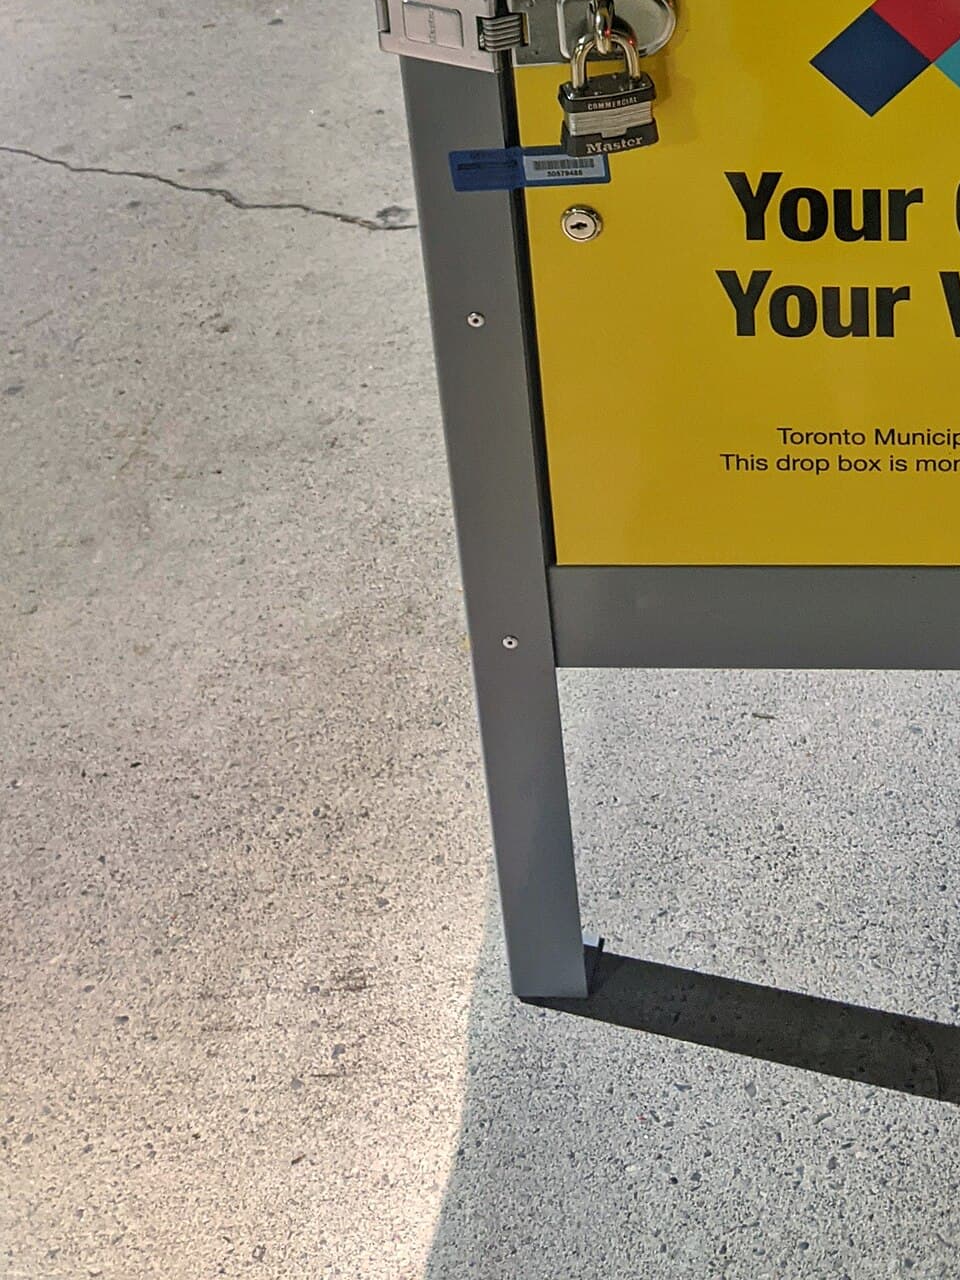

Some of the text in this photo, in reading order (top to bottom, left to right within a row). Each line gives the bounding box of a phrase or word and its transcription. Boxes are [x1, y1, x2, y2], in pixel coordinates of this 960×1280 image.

[587, 96, 637, 110] COMMERCIAL
[585, 136, 643, 154] Master
[723, 171, 924, 243] Your
[714, 269, 911, 338] Your
[776, 427, 866, 447] Toronto
[719, 453, 769, 472] This
[776, 453, 830, 476] drop
[838, 454, 882, 473] box
[889, 454, 908, 473] is
